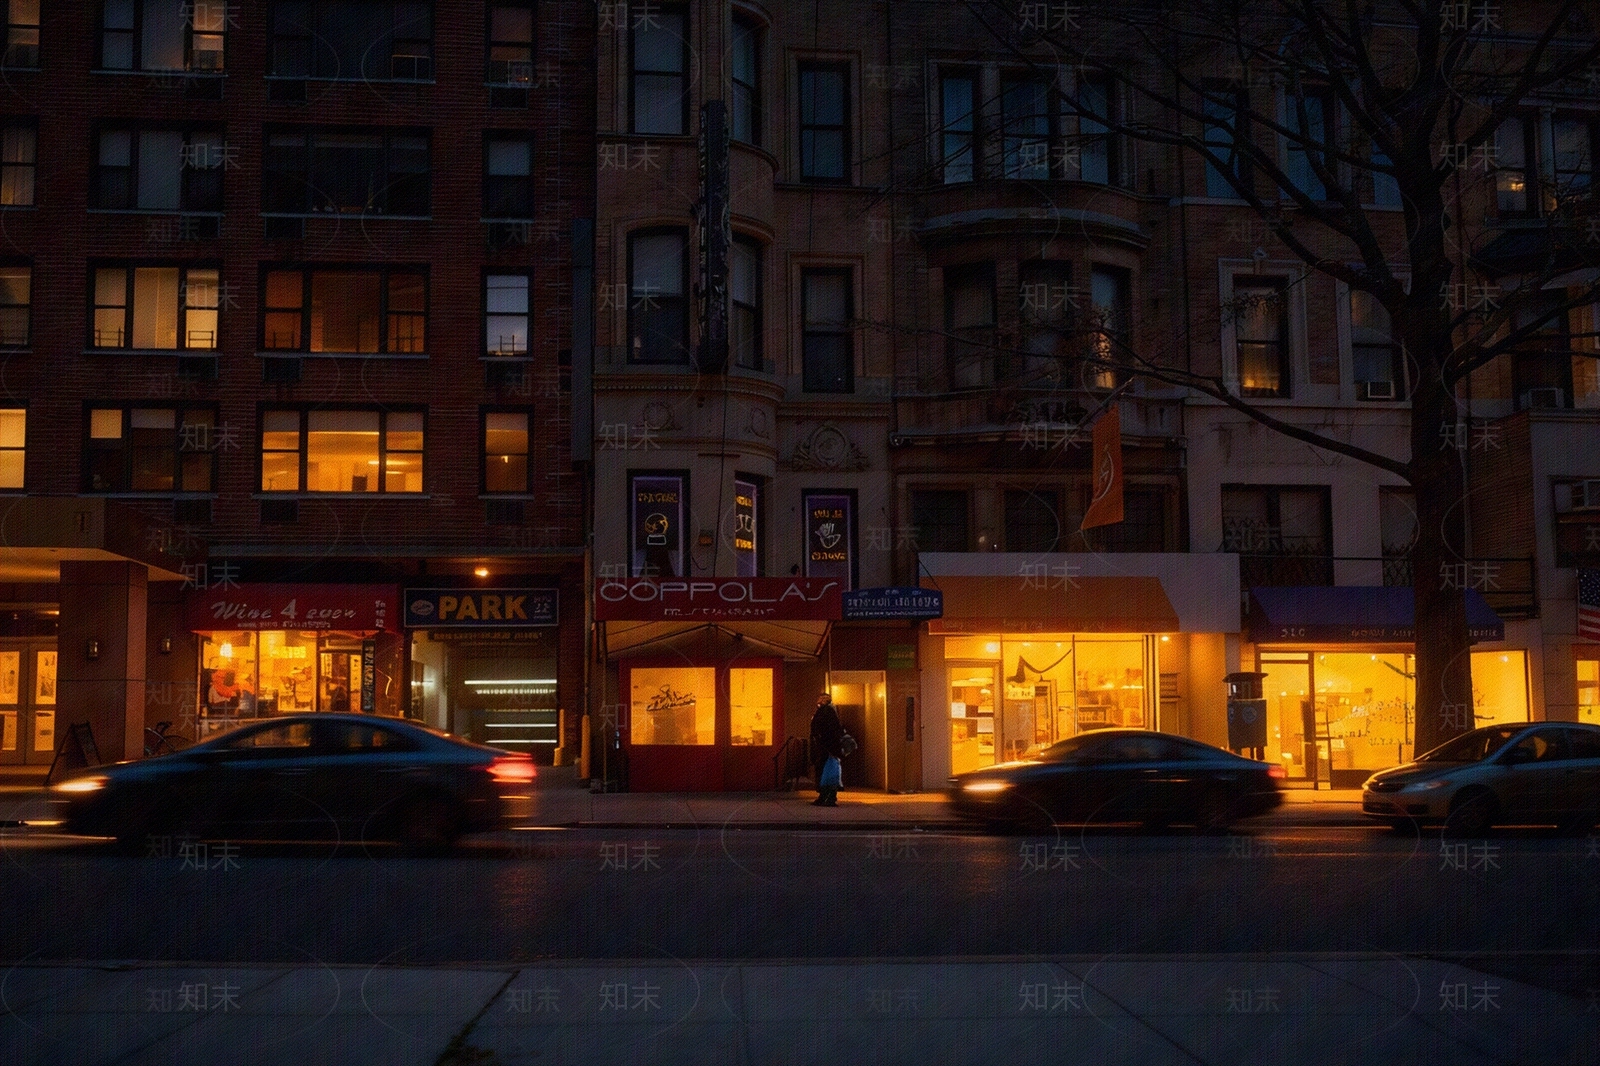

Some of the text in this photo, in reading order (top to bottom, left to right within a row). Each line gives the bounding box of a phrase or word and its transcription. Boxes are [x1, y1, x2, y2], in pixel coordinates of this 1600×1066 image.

[599, 581, 838, 603] COPPOLA'S
[210, 600, 272, 620] Wine
[280, 598, 299, 620] 4
[438, 594, 528, 621] PARK
